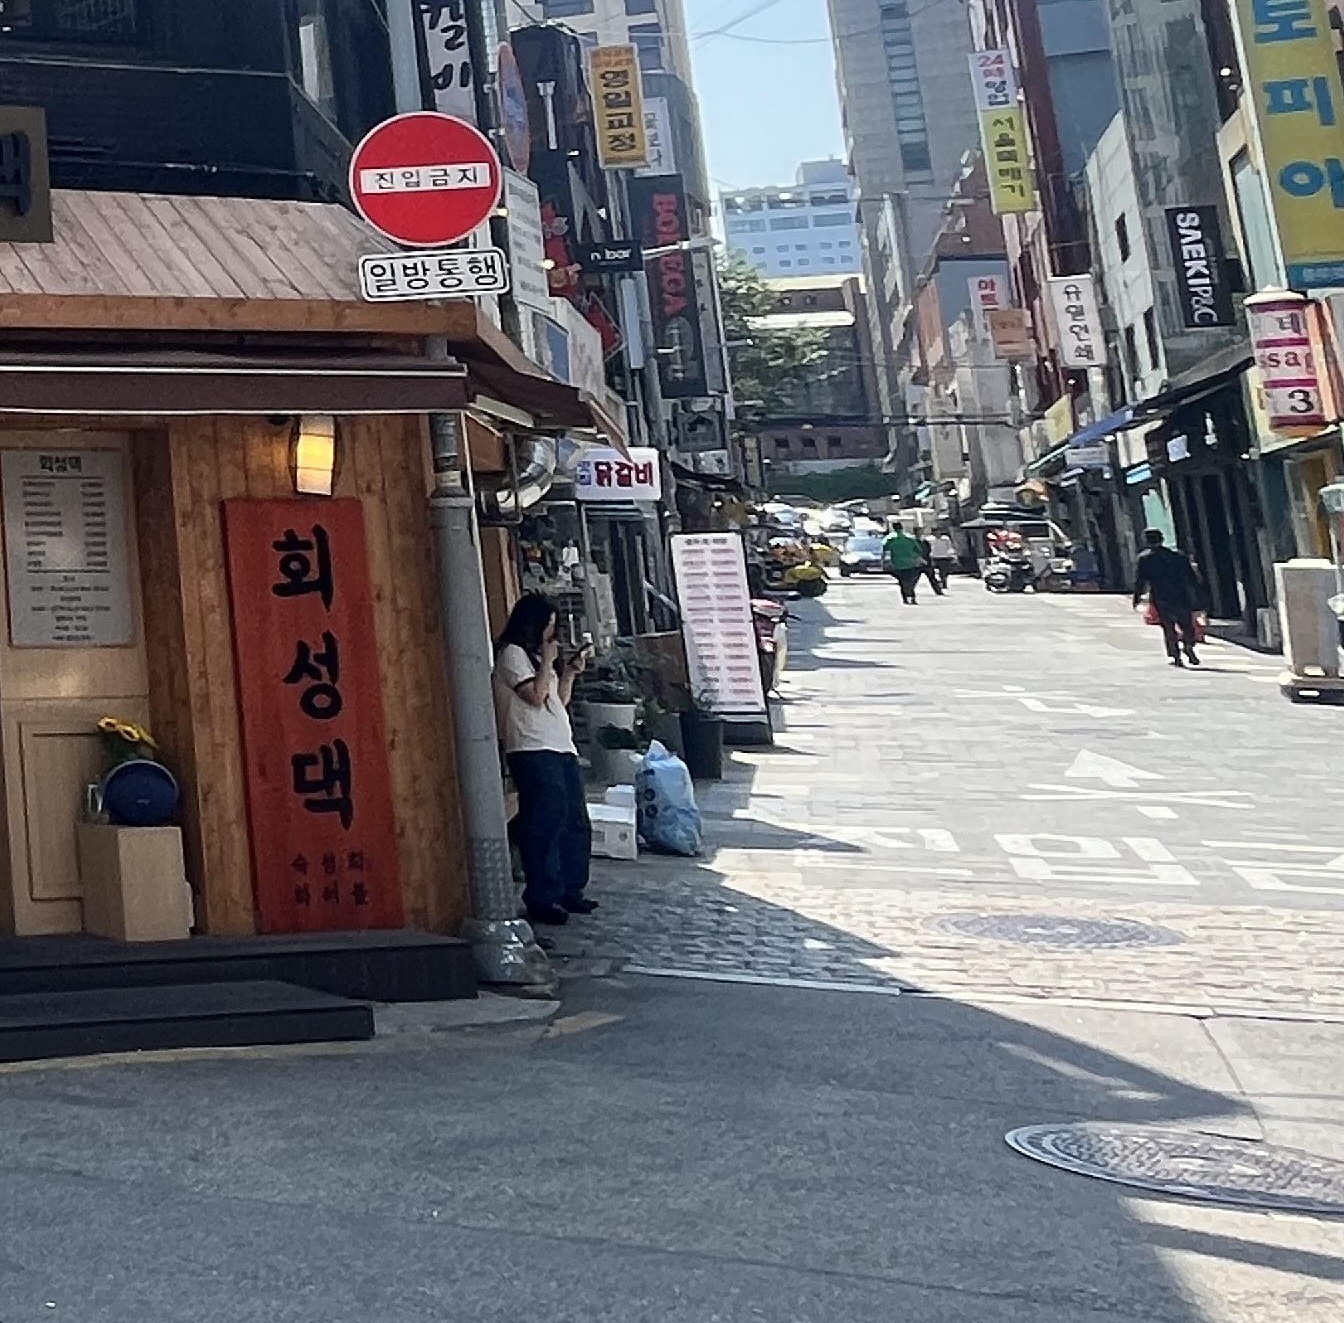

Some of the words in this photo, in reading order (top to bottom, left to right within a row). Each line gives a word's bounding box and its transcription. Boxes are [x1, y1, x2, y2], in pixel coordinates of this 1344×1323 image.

[374, 165, 480, 191] 진입금지
[369, 254, 500, 293] 일방통행
[271, 523, 356, 832] 회성댁
